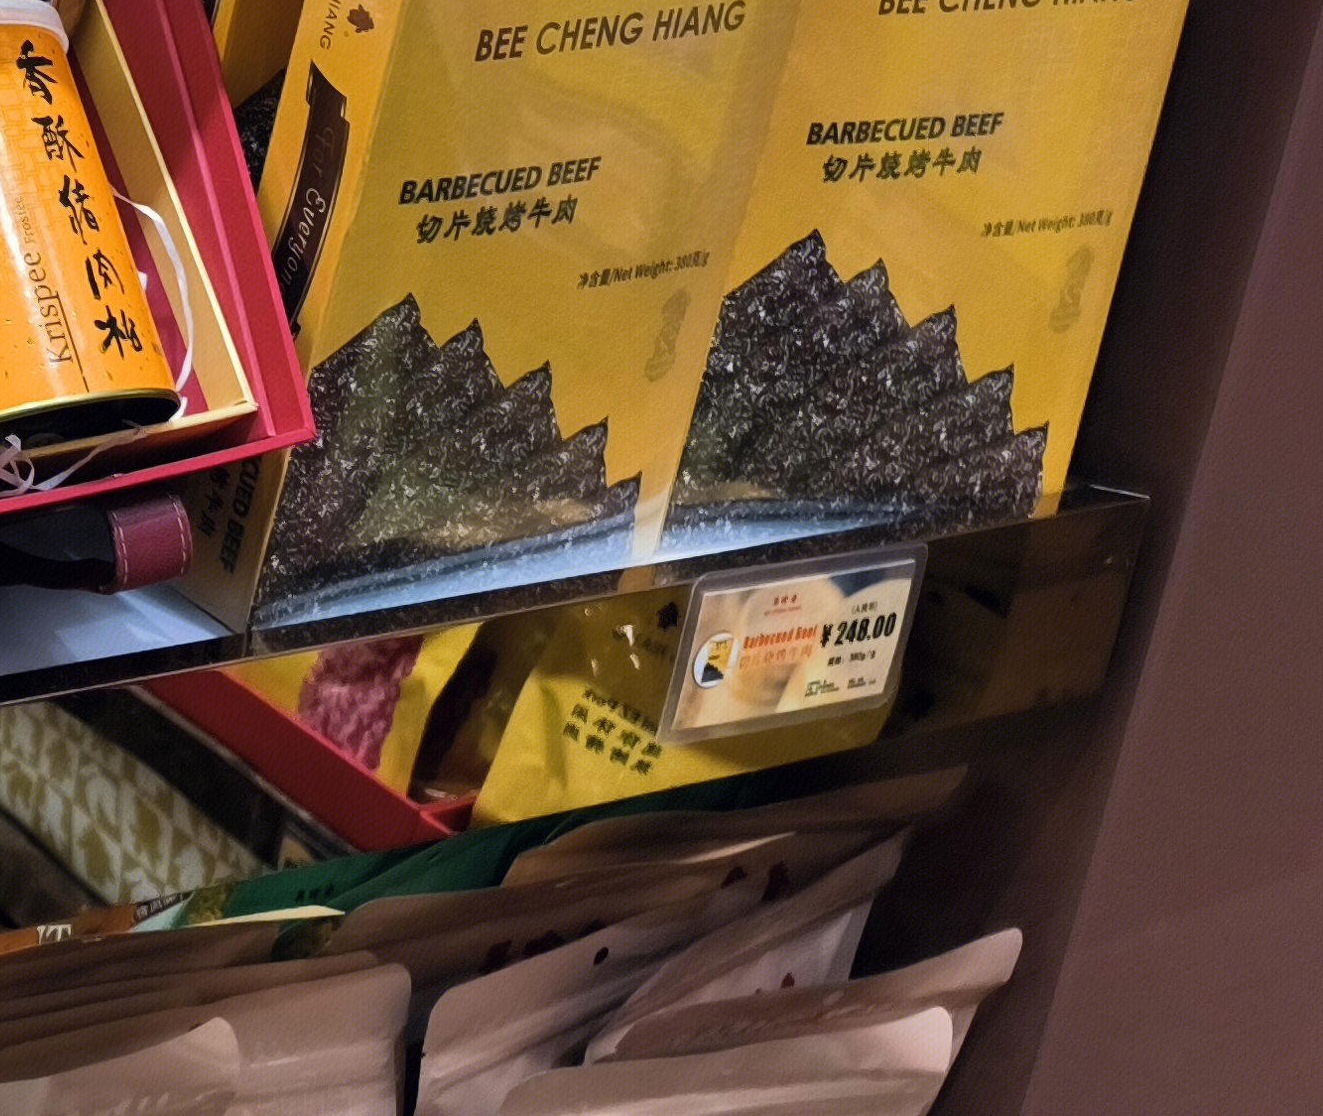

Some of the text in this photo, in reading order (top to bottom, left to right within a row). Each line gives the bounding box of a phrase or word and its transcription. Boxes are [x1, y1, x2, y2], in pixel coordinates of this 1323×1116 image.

[475, 0, 746, 61] BEE CHENG HIANG
[806, 112, 1004, 146] BARBECUED BEEF
[398, 156, 602, 205] BARBECUED BEEF
[822, 146, 982, 183] 切片烧烤牛肉
[279, 184, 328, 295] Everyon
[415, 195, 578, 243] 切片烧烤牛肉
